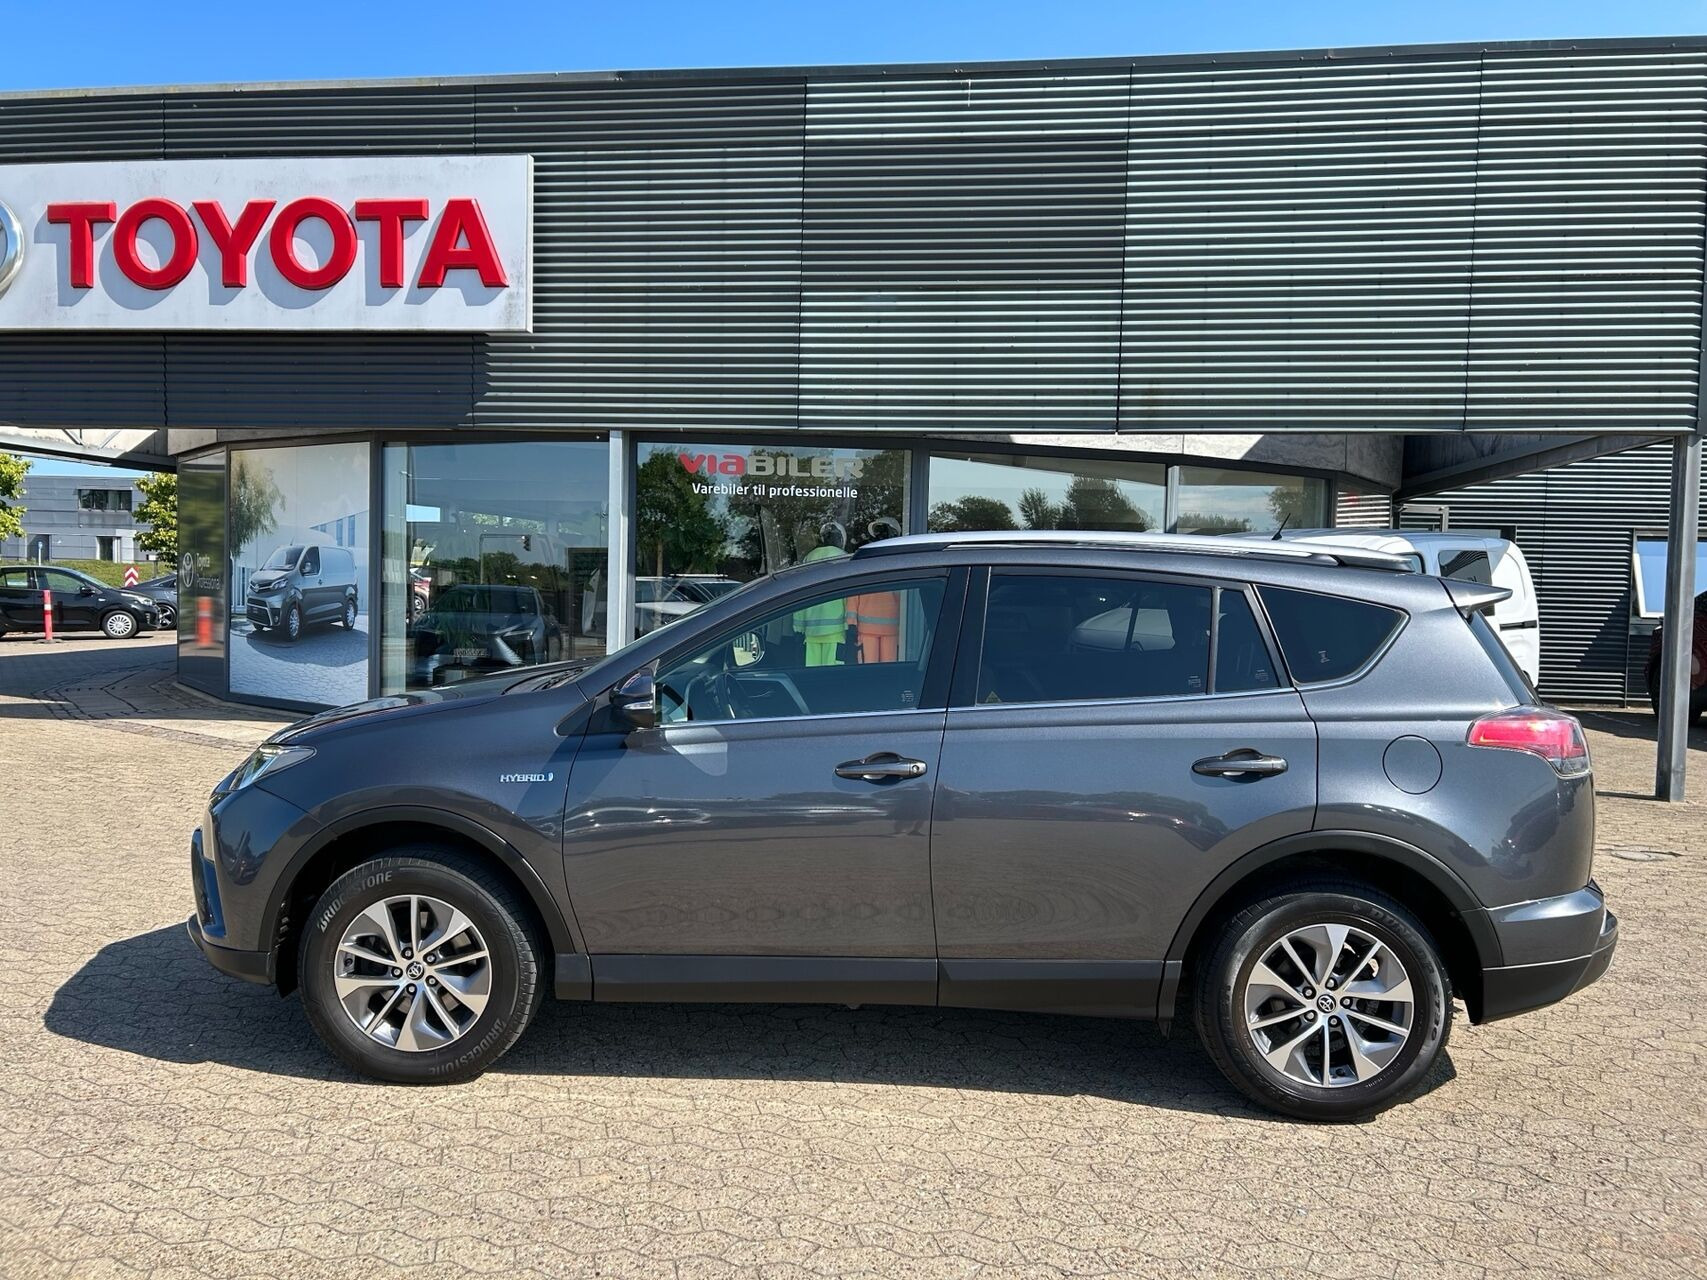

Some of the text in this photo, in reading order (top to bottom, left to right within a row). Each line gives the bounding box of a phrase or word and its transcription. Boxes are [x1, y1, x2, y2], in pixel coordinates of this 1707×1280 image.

[47, 197, 510, 290] TOYOTA
[692, 483, 858, 498] Varebiler til professionelle
[500, 773, 546, 782] HYBRID
